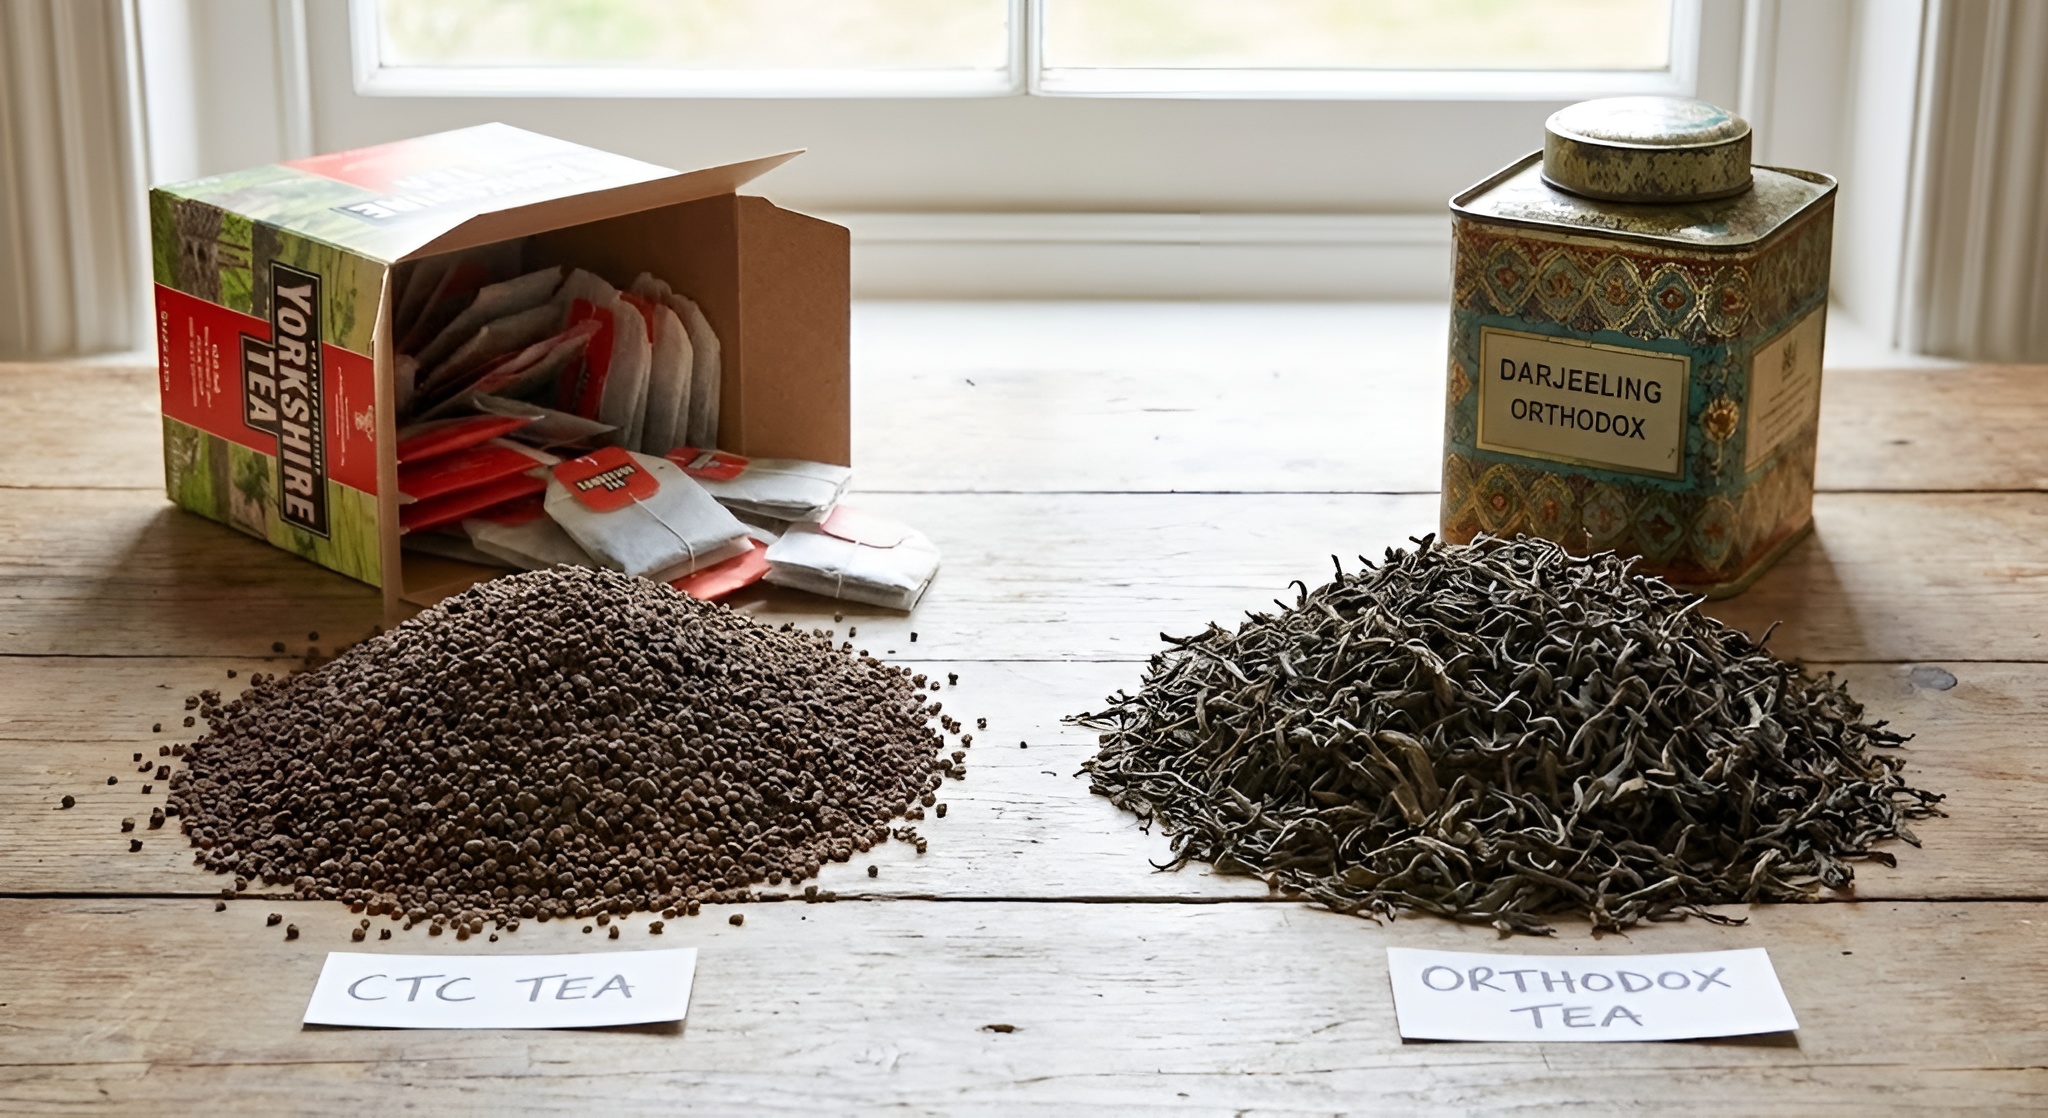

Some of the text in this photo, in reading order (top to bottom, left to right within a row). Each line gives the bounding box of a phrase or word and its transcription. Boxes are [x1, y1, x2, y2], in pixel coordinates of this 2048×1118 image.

[247, 349, 277, 422] TEA
[1500, 358, 1662, 404] DARJEELING
[277, 284, 315, 524] YORKSHIRE
[1510, 398, 1646, 440] ORTHODOX
[347, 973, 636, 1003] CTC TEA
[1421, 965, 1732, 994] ORTHODOX
[1510, 1003, 1643, 1029] TEA
